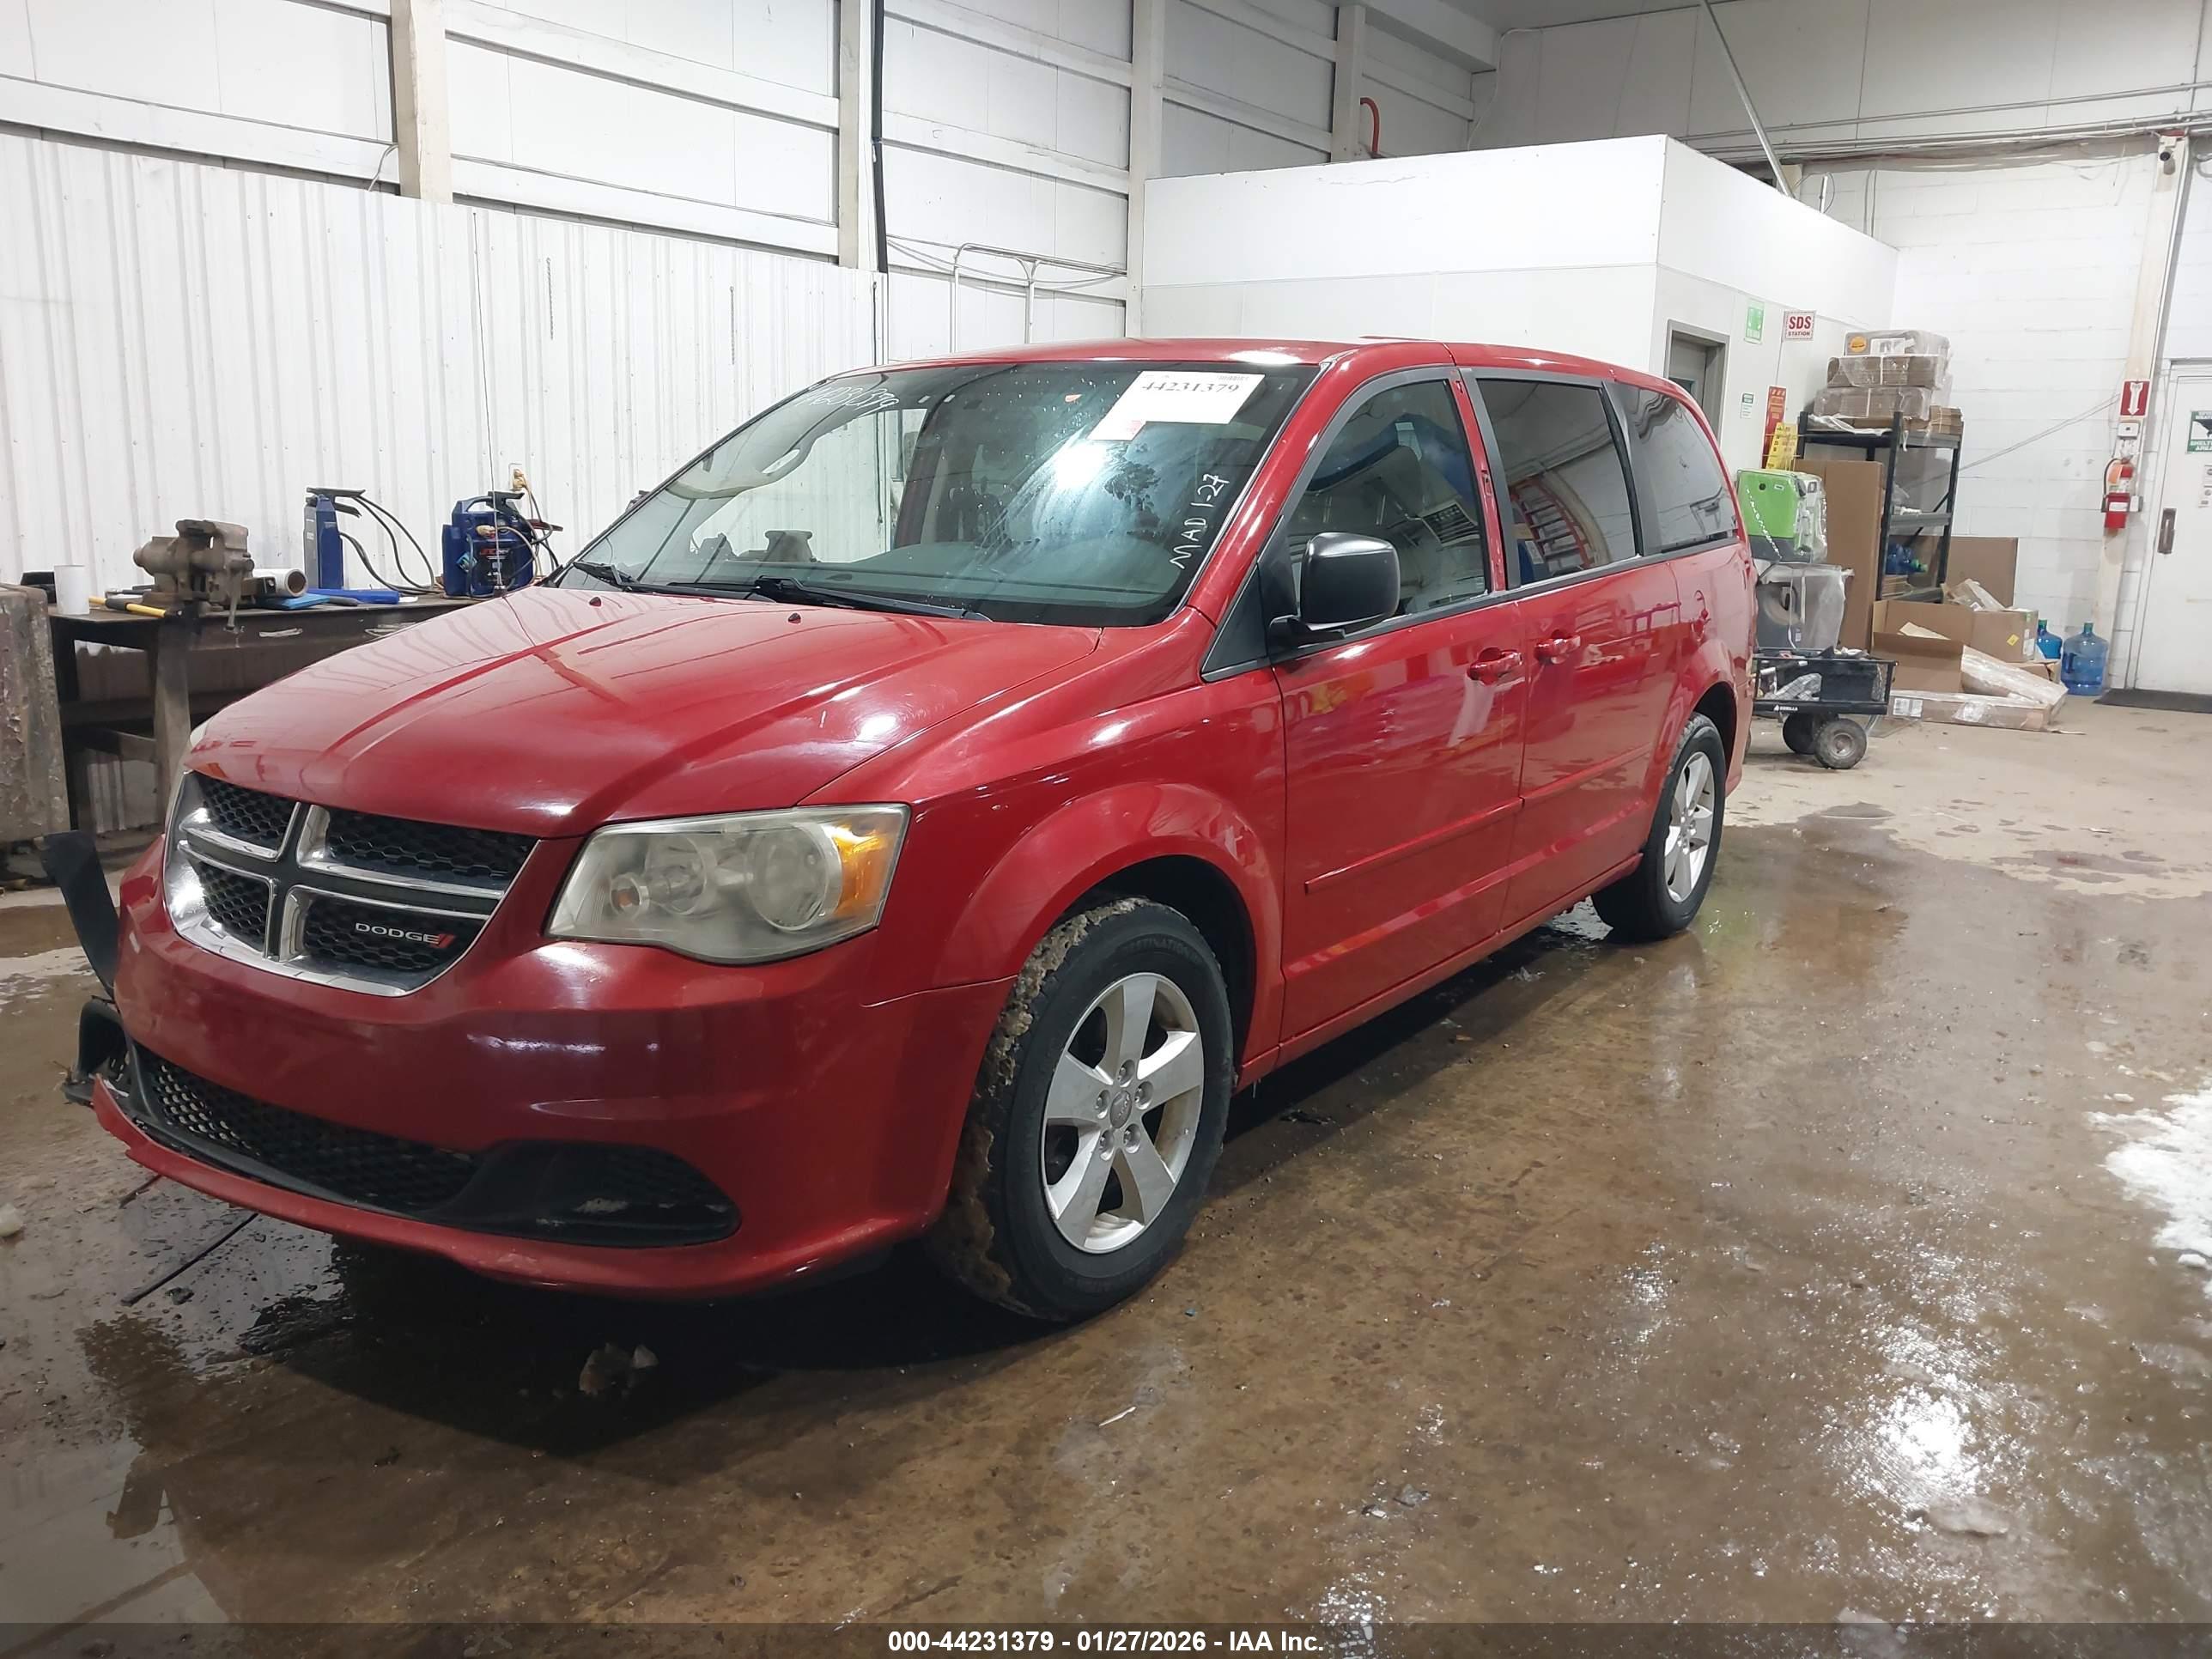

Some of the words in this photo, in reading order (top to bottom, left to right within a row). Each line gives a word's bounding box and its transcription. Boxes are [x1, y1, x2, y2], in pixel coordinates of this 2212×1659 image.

[1788, 315, 1812, 330] SDS
[1142, 381, 1240, 392] 44231379
[1169, 517, 1206, 569] MAD
[355, 922, 441, 945] DODGE
